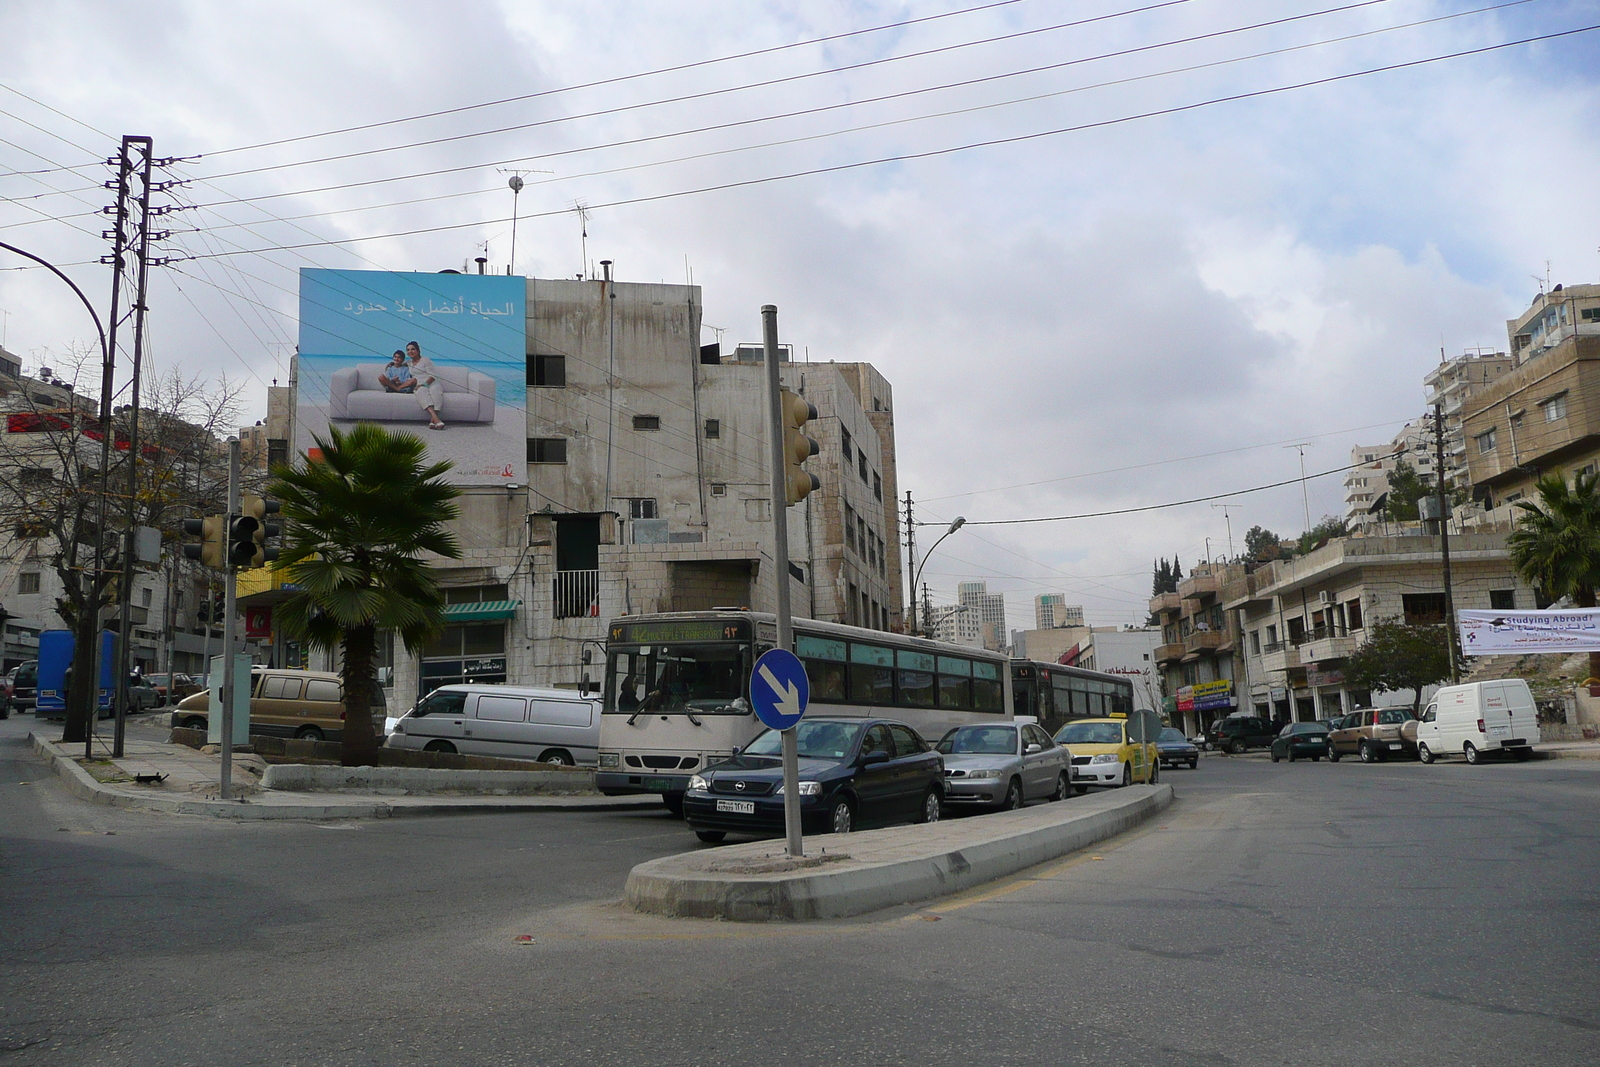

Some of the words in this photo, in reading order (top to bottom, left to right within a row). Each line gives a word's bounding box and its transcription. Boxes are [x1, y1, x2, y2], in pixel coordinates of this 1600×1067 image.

[344, 301, 388, 316] حدود
[395, 299, 415, 317] بلا
[420, 296, 465, 316] أفضل
[470, 301, 514, 320] الحياة
[1506, 616, 1550, 625] Studying
[1553, 614, 1593, 623] Abroad?
